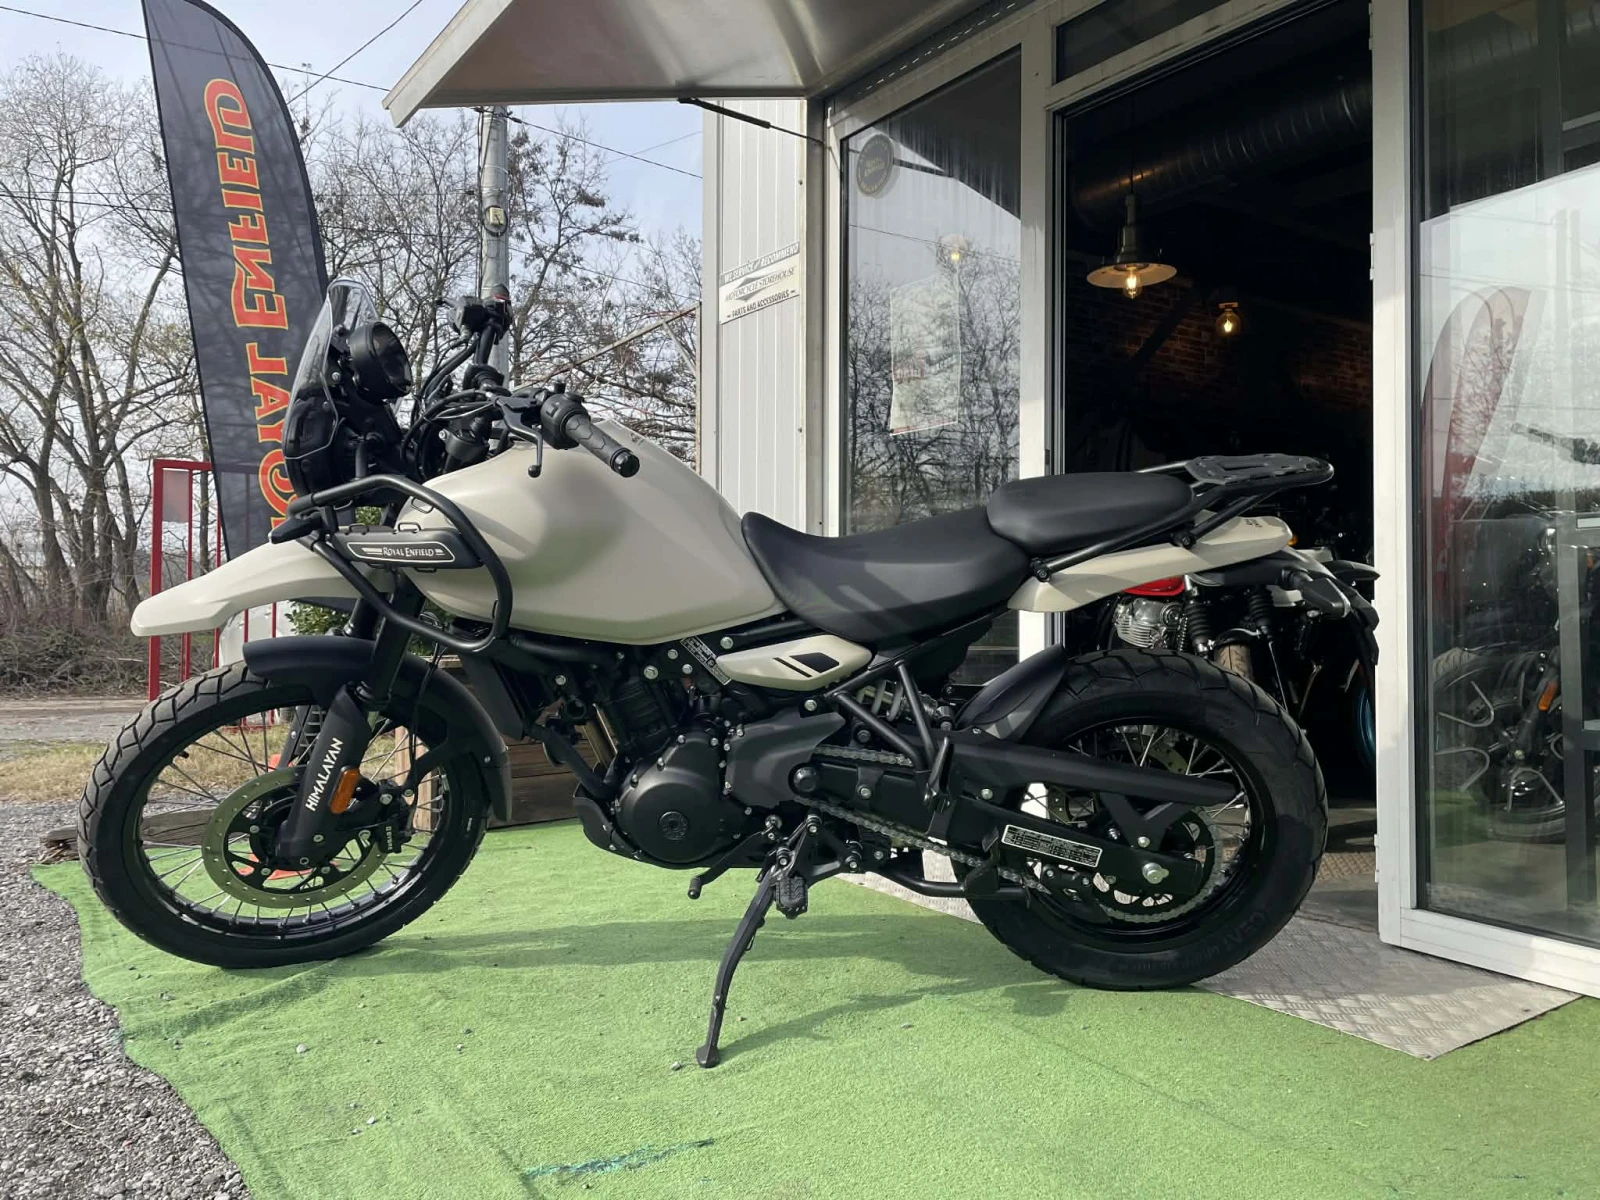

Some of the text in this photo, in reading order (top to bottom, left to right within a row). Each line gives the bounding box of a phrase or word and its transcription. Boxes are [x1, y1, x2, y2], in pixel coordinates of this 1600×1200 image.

[732, 289, 790, 318] PARTS AND ACCESSORIES
[383, 546, 435, 557] ROYAL ENFIELD
[305, 737, 344, 812] HIMALAYAN
